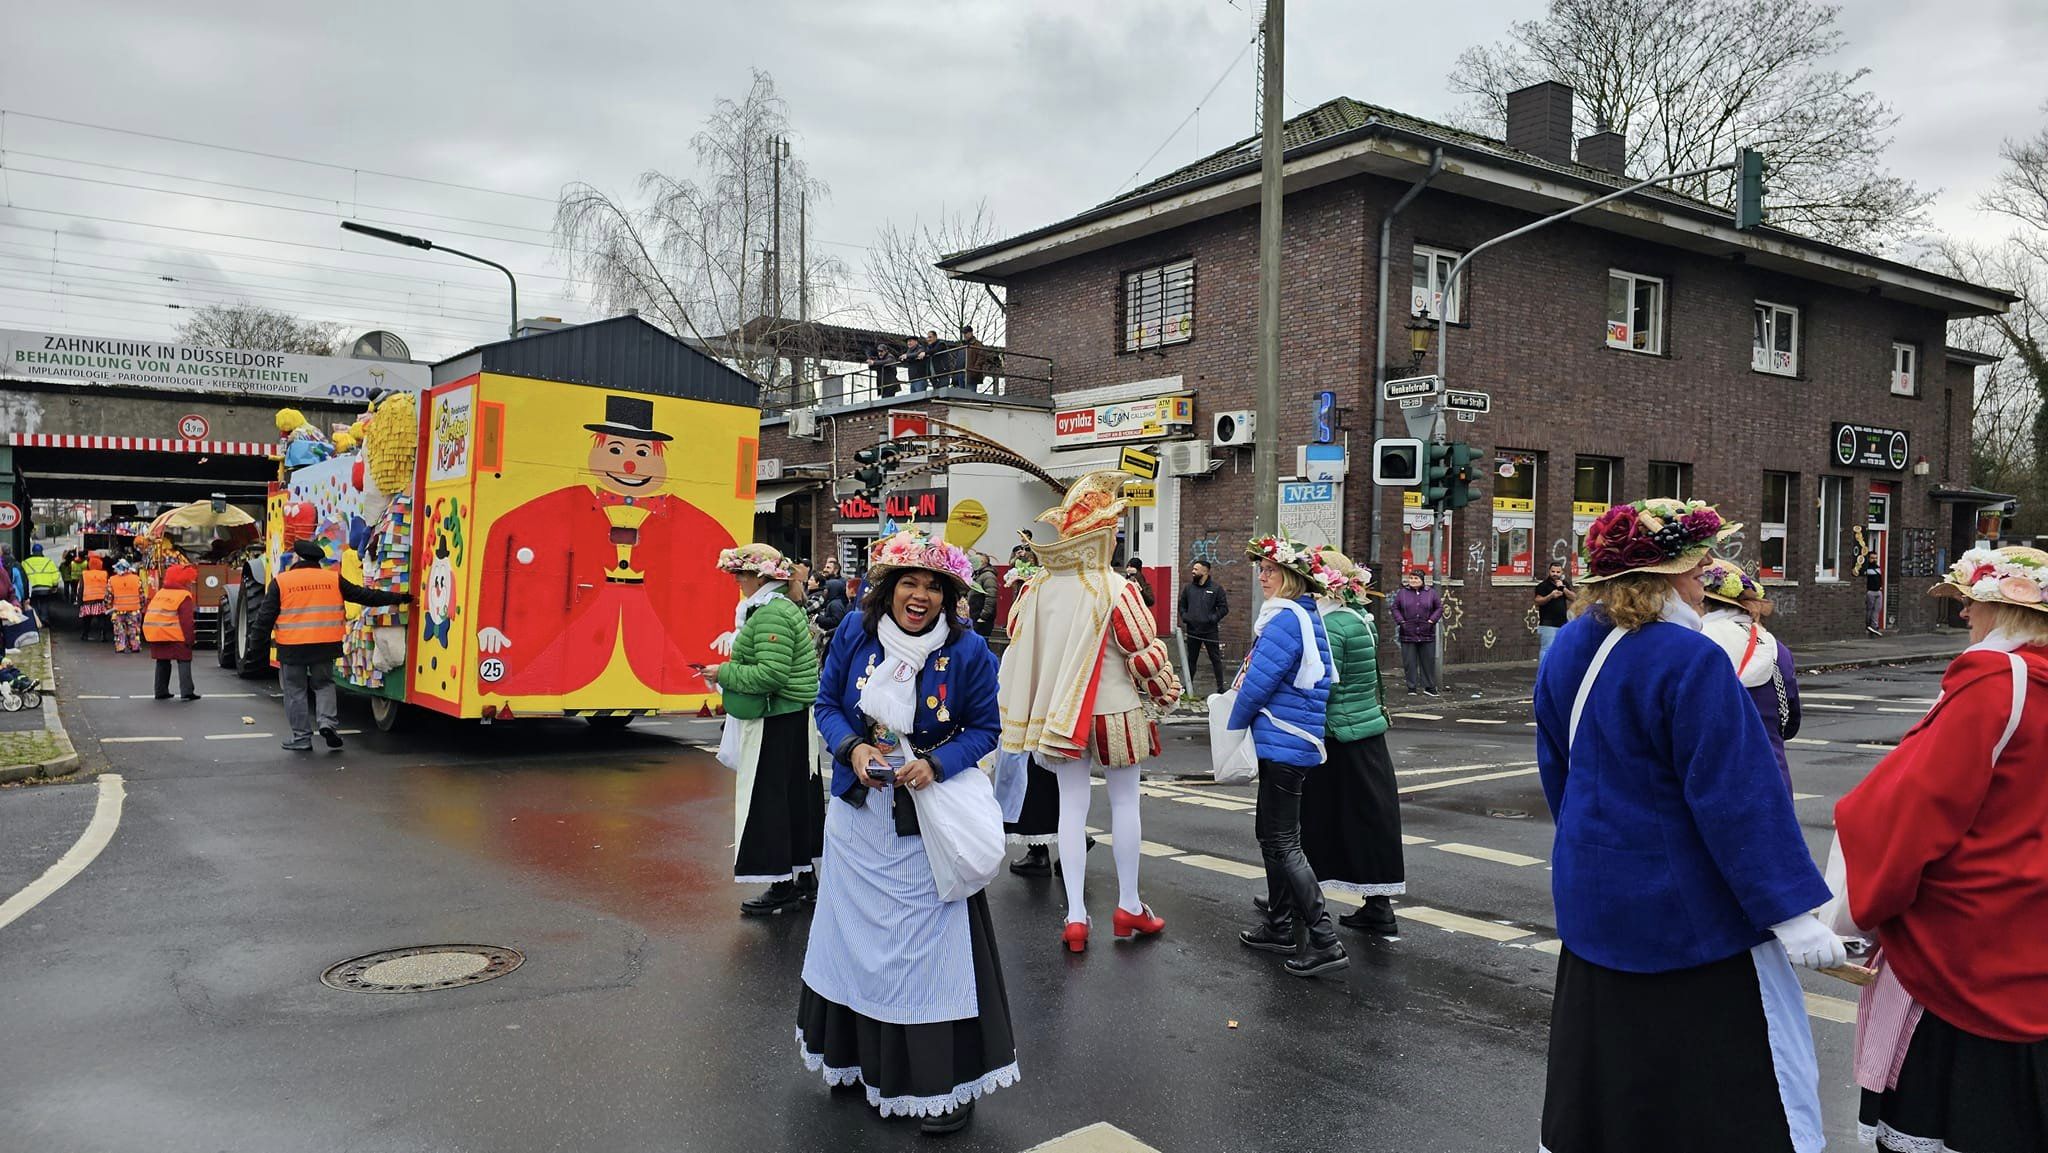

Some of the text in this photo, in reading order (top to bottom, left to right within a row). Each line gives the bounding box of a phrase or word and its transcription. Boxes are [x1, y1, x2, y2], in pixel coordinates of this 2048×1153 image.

[44, 336, 286, 368] ZAHNKLINIK IN DÜSSELDORF
[15, 350, 308, 384] BEHANDLUNG VON ANGSTPATIENTEN
[28, 366, 110, 380] IMPLANTOLOGIE
[118, 373, 204, 387] PARODONTOLOGIE
[1286, 485, 1330, 501] NRZ
[483, 661, 501, 678] 25
